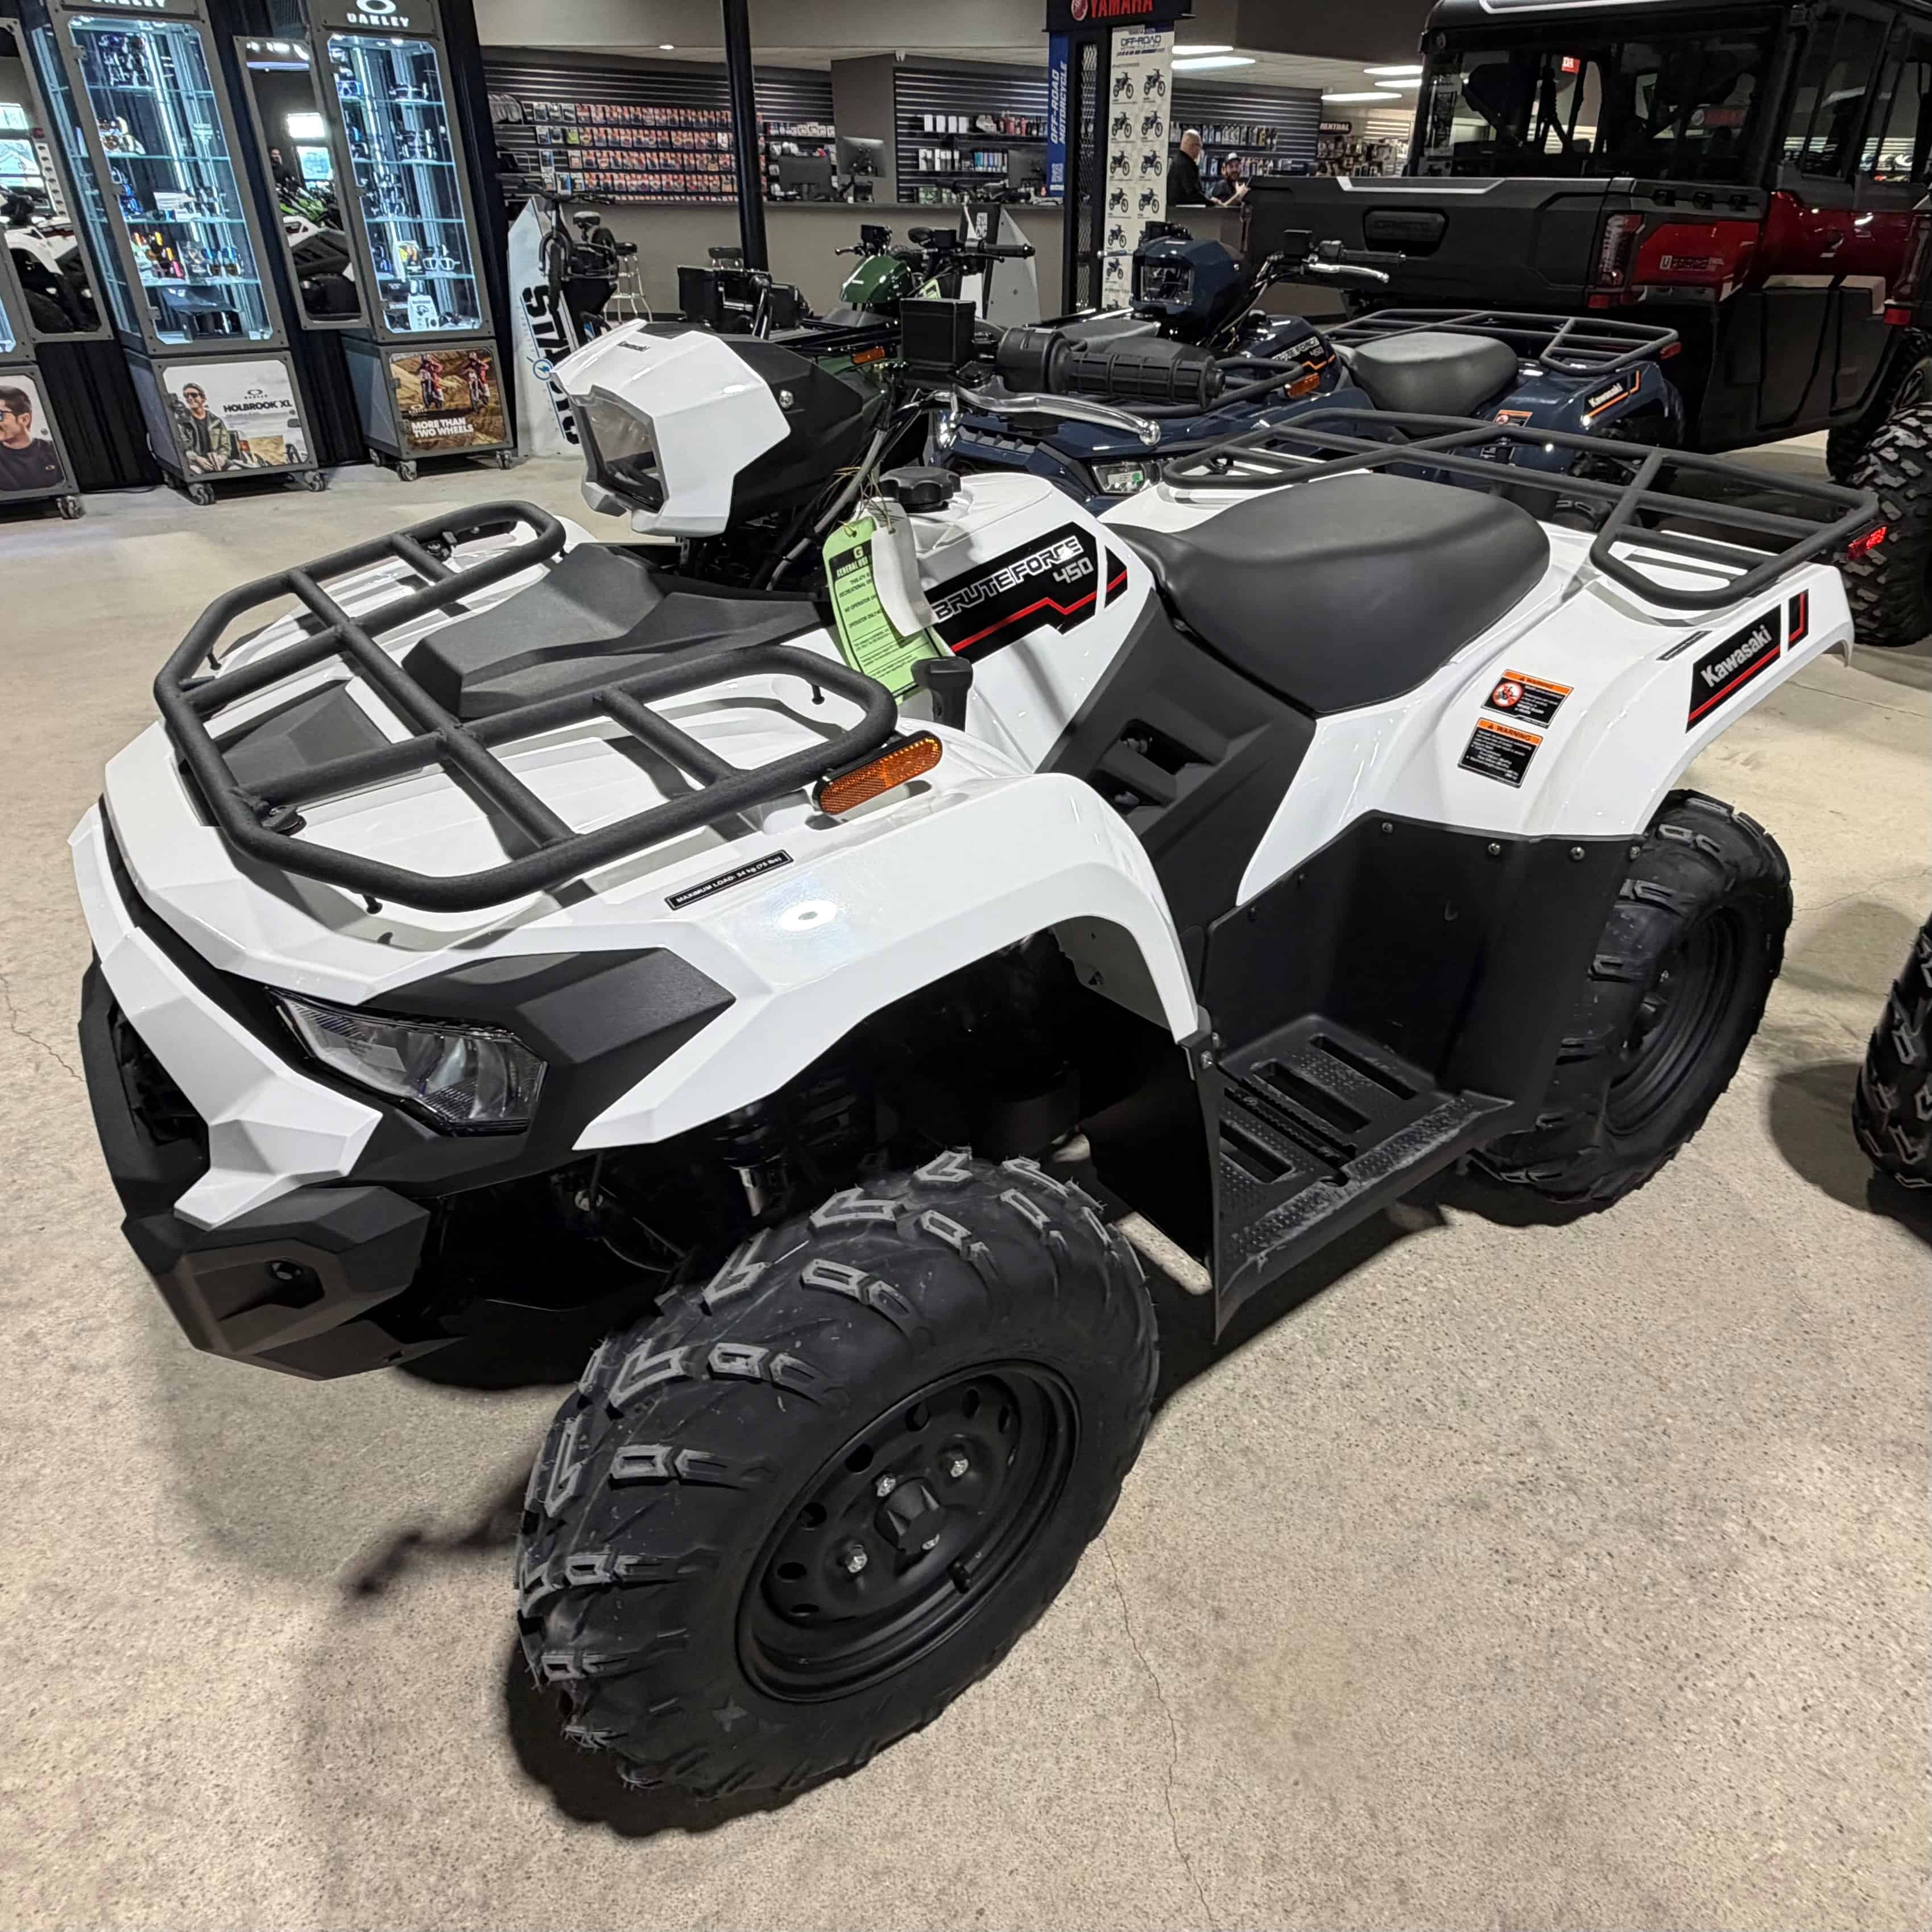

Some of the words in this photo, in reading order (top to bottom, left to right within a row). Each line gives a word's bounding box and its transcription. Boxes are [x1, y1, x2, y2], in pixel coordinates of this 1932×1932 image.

[1091, 0, 1153, 18] YAMAHA
[346, 12, 409, 27] OAKLEY
[1120, 35, 1161, 47] OFF-ROAD
[1050, 69, 1060, 144] OFF-ROAD
[1058, 60, 1067, 144] MOTORCYCLE
[223, 400, 278, 413] HOLBROOK
[279, 399, 292, 408] XL
[411, 419, 440, 431] MORE
[440, 416, 466, 427] THAN
[413, 428, 436, 438] TWO
[437, 424, 474, 436] WHEELS
[854, 546, 864, 558] G
[1052, 557, 1094, 584] 450
[1701, 624, 1772, 688] Kawasaki
[676, 884, 713, 903] MAXIMUM
